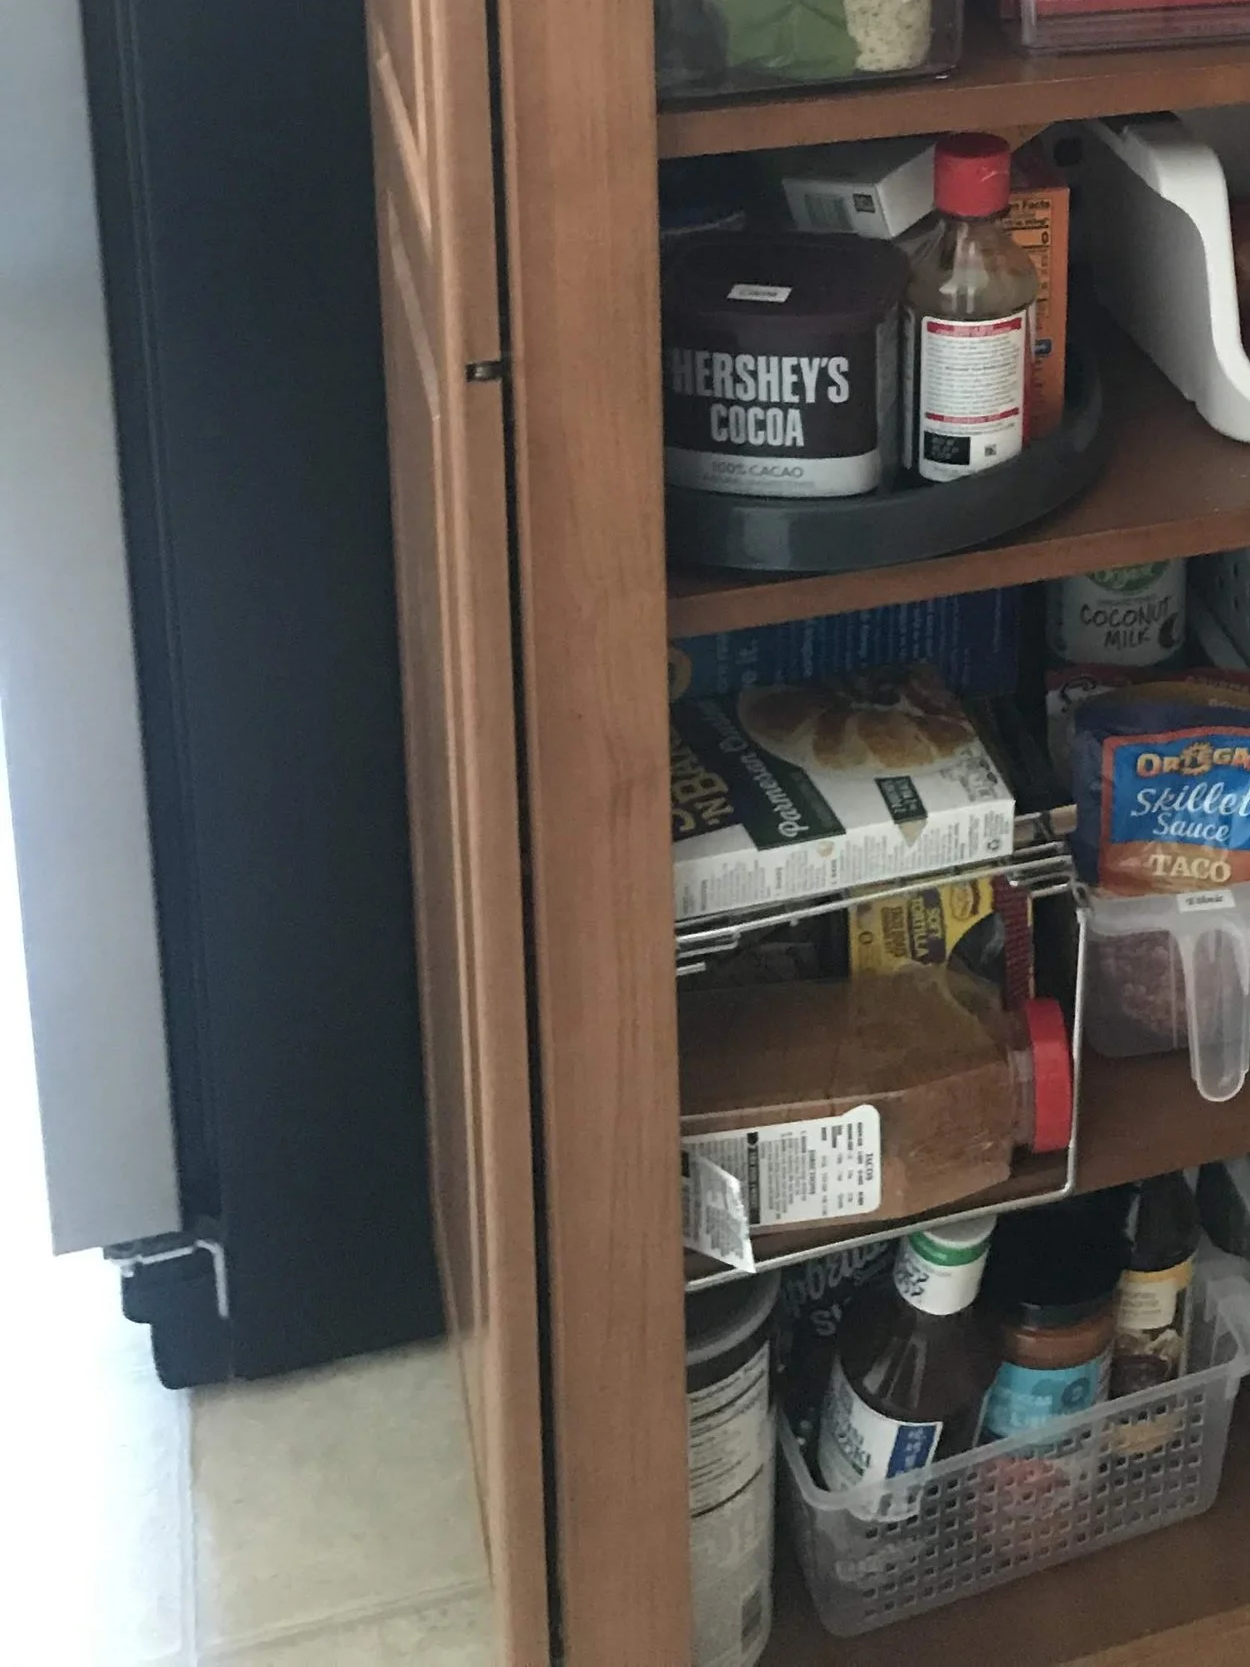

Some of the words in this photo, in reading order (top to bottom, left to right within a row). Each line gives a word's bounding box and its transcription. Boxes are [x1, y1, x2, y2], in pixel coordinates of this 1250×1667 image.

[671, 347, 850, 404] HERSHEY'S
[710, 402, 805, 448] COCOA
[748, 464, 805, 479] CACAO
[1080, 596, 1173, 628] COCONUT
[1104, 626, 1152, 651] MILK
[740, 751, 810, 839] Parmesan
[1152, 812, 1230, 843] Sauce
[1150, 853, 1232, 883] TACO
